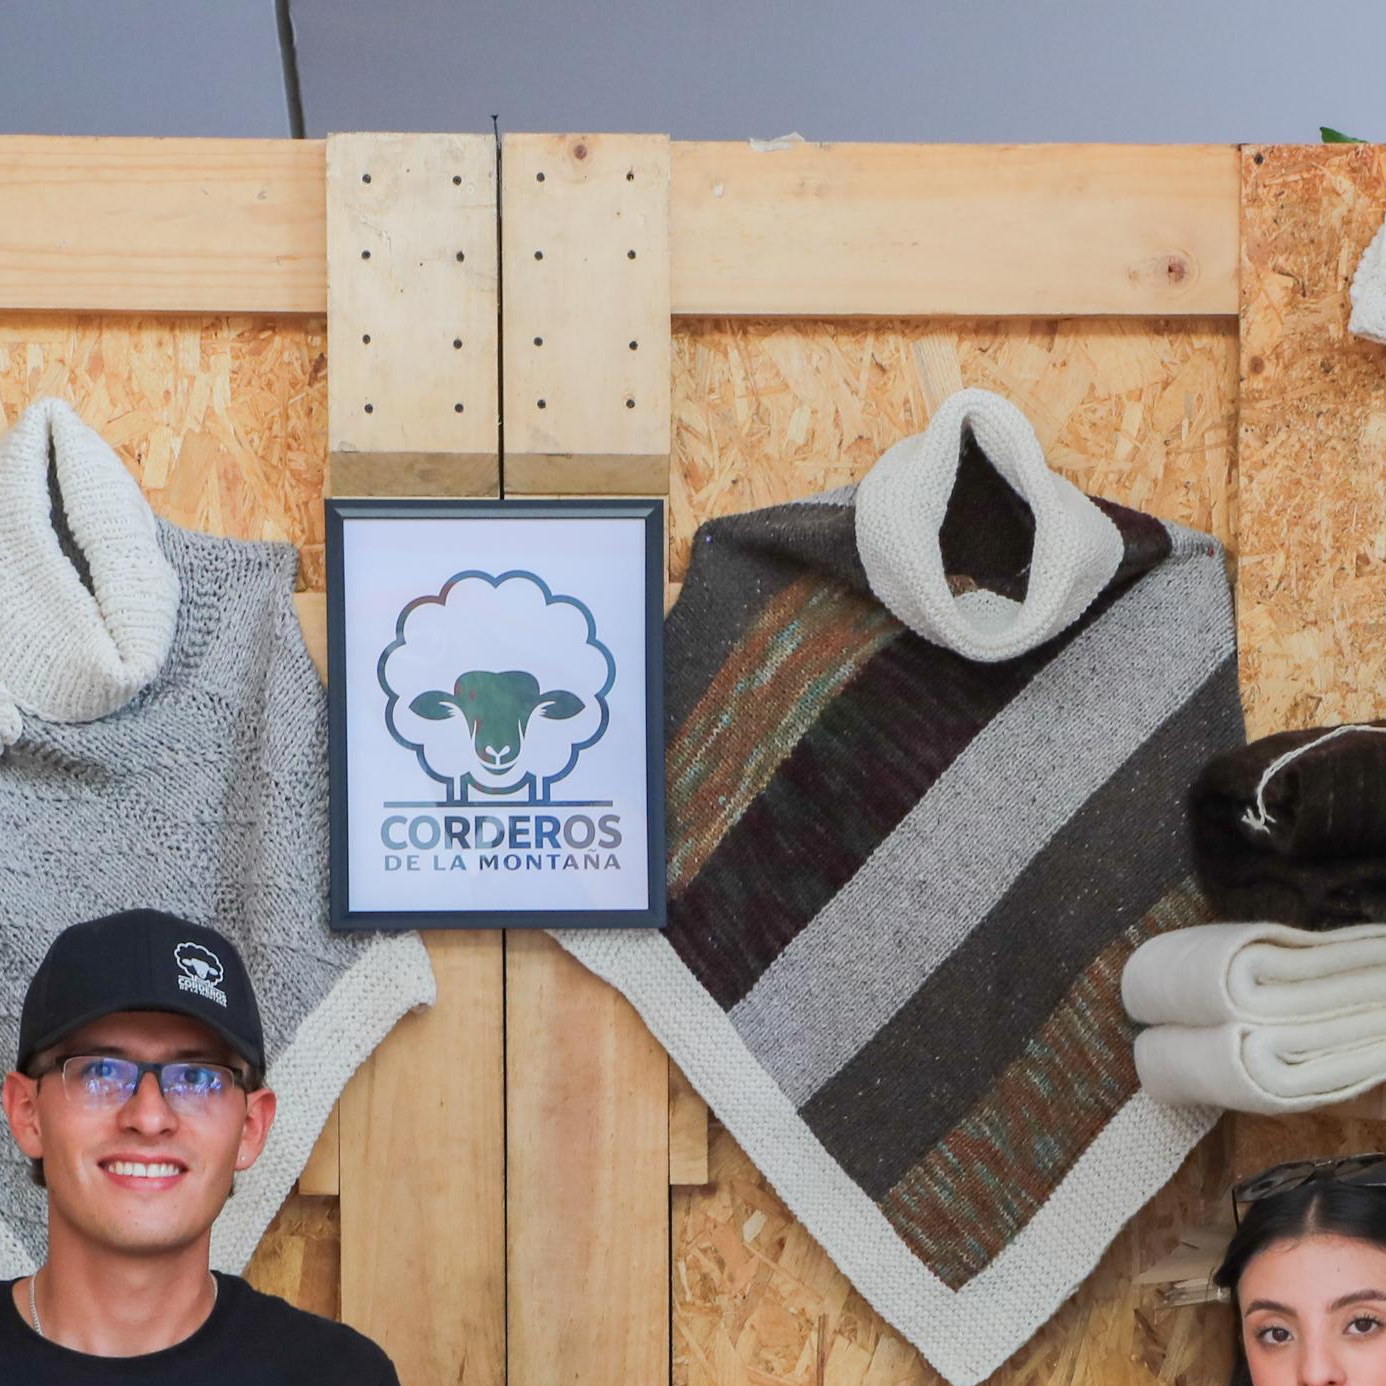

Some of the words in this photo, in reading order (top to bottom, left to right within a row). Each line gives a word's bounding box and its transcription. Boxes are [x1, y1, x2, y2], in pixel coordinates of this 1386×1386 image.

[380, 814, 623, 850] CORDEROS
[384, 854, 420, 871] DE
[433, 854, 467, 871] LA
[479, 849, 622, 871] MONTAÑA
